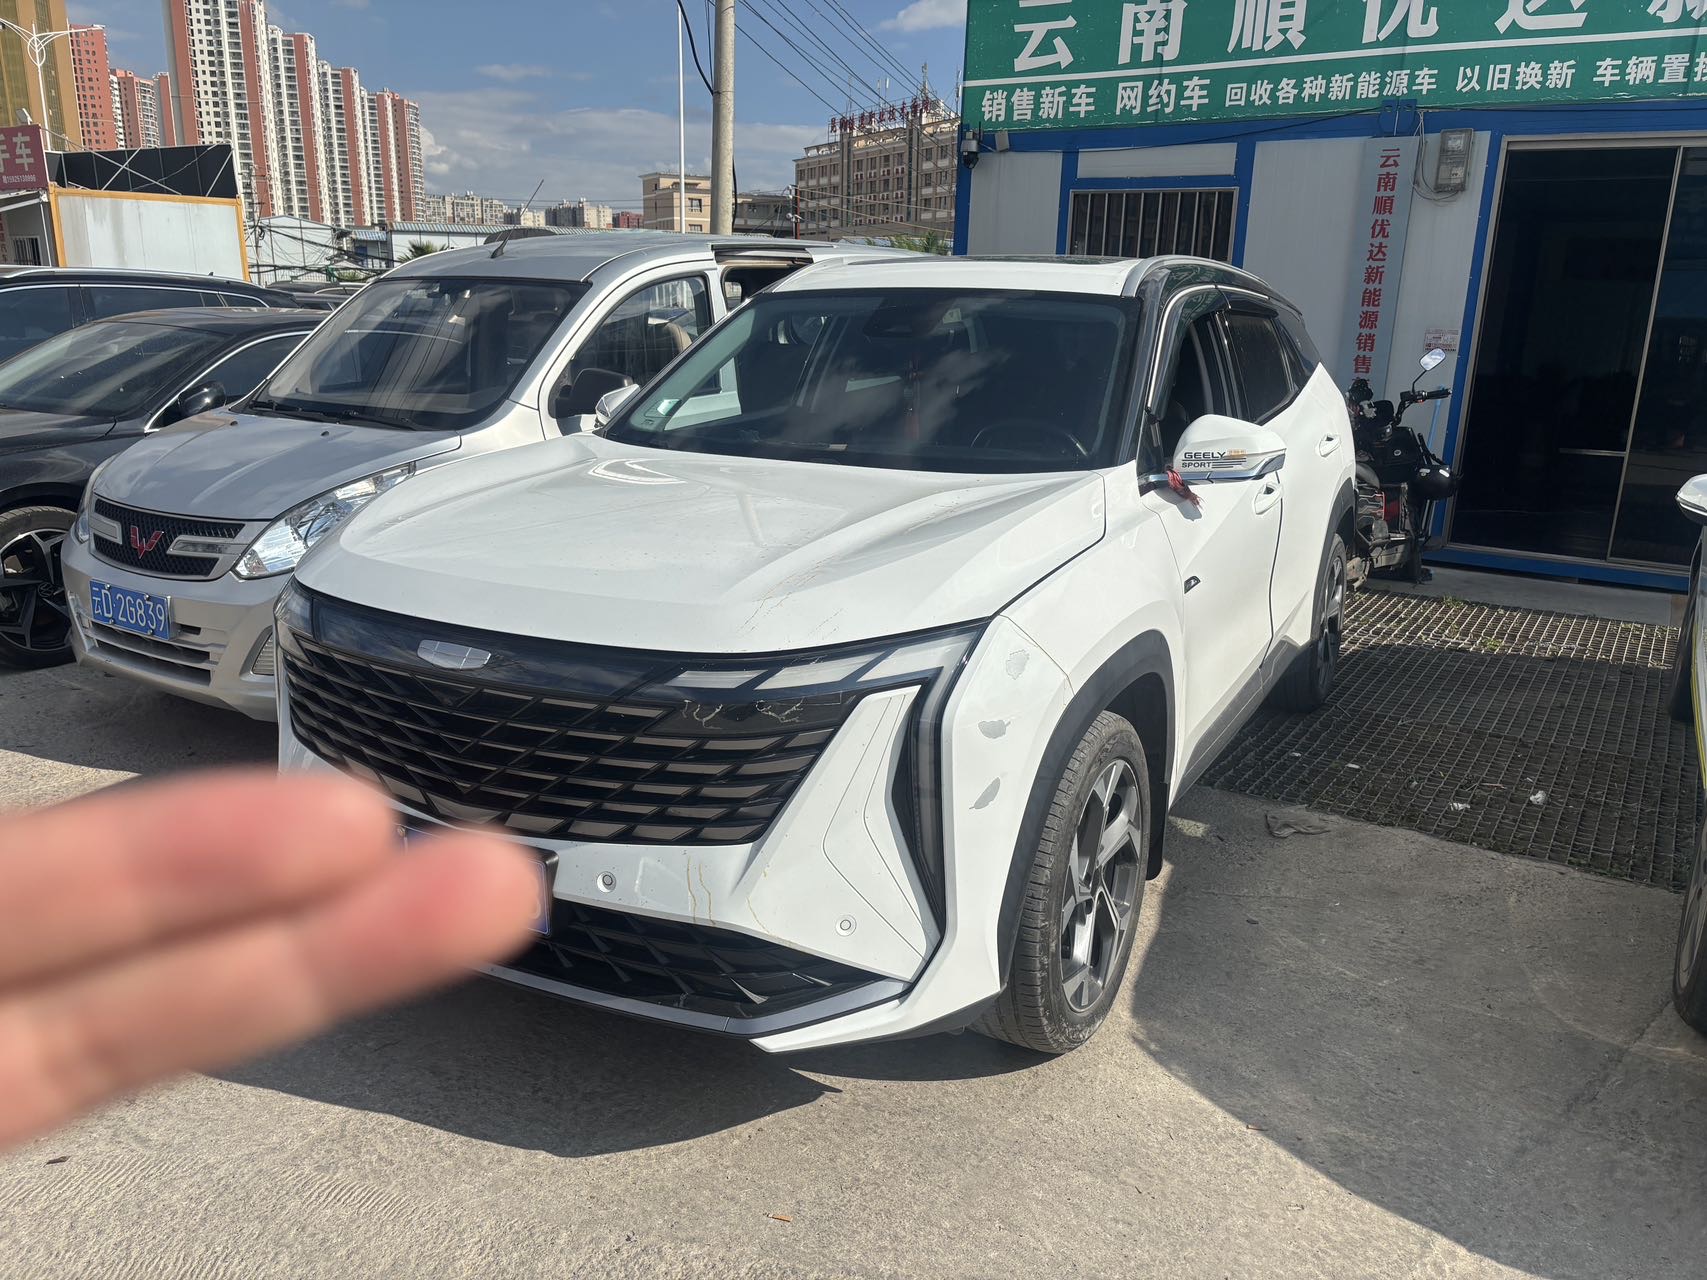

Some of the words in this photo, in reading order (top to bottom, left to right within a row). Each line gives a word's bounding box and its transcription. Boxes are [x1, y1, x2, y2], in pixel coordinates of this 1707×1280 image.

[981, 84, 1097, 122] 销售新车
[1115, 76, 1211, 116] 网约车
[1225, 67, 1439, 108] 回收各种新能源车
[1455, 59, 1577, 93] 以旧换新
[1351, 148, 1401, 385] 云南順优达新能源销售
[1181, 461, 1212, 469] SPORT
[1183, 451, 1226, 459] GEELY
